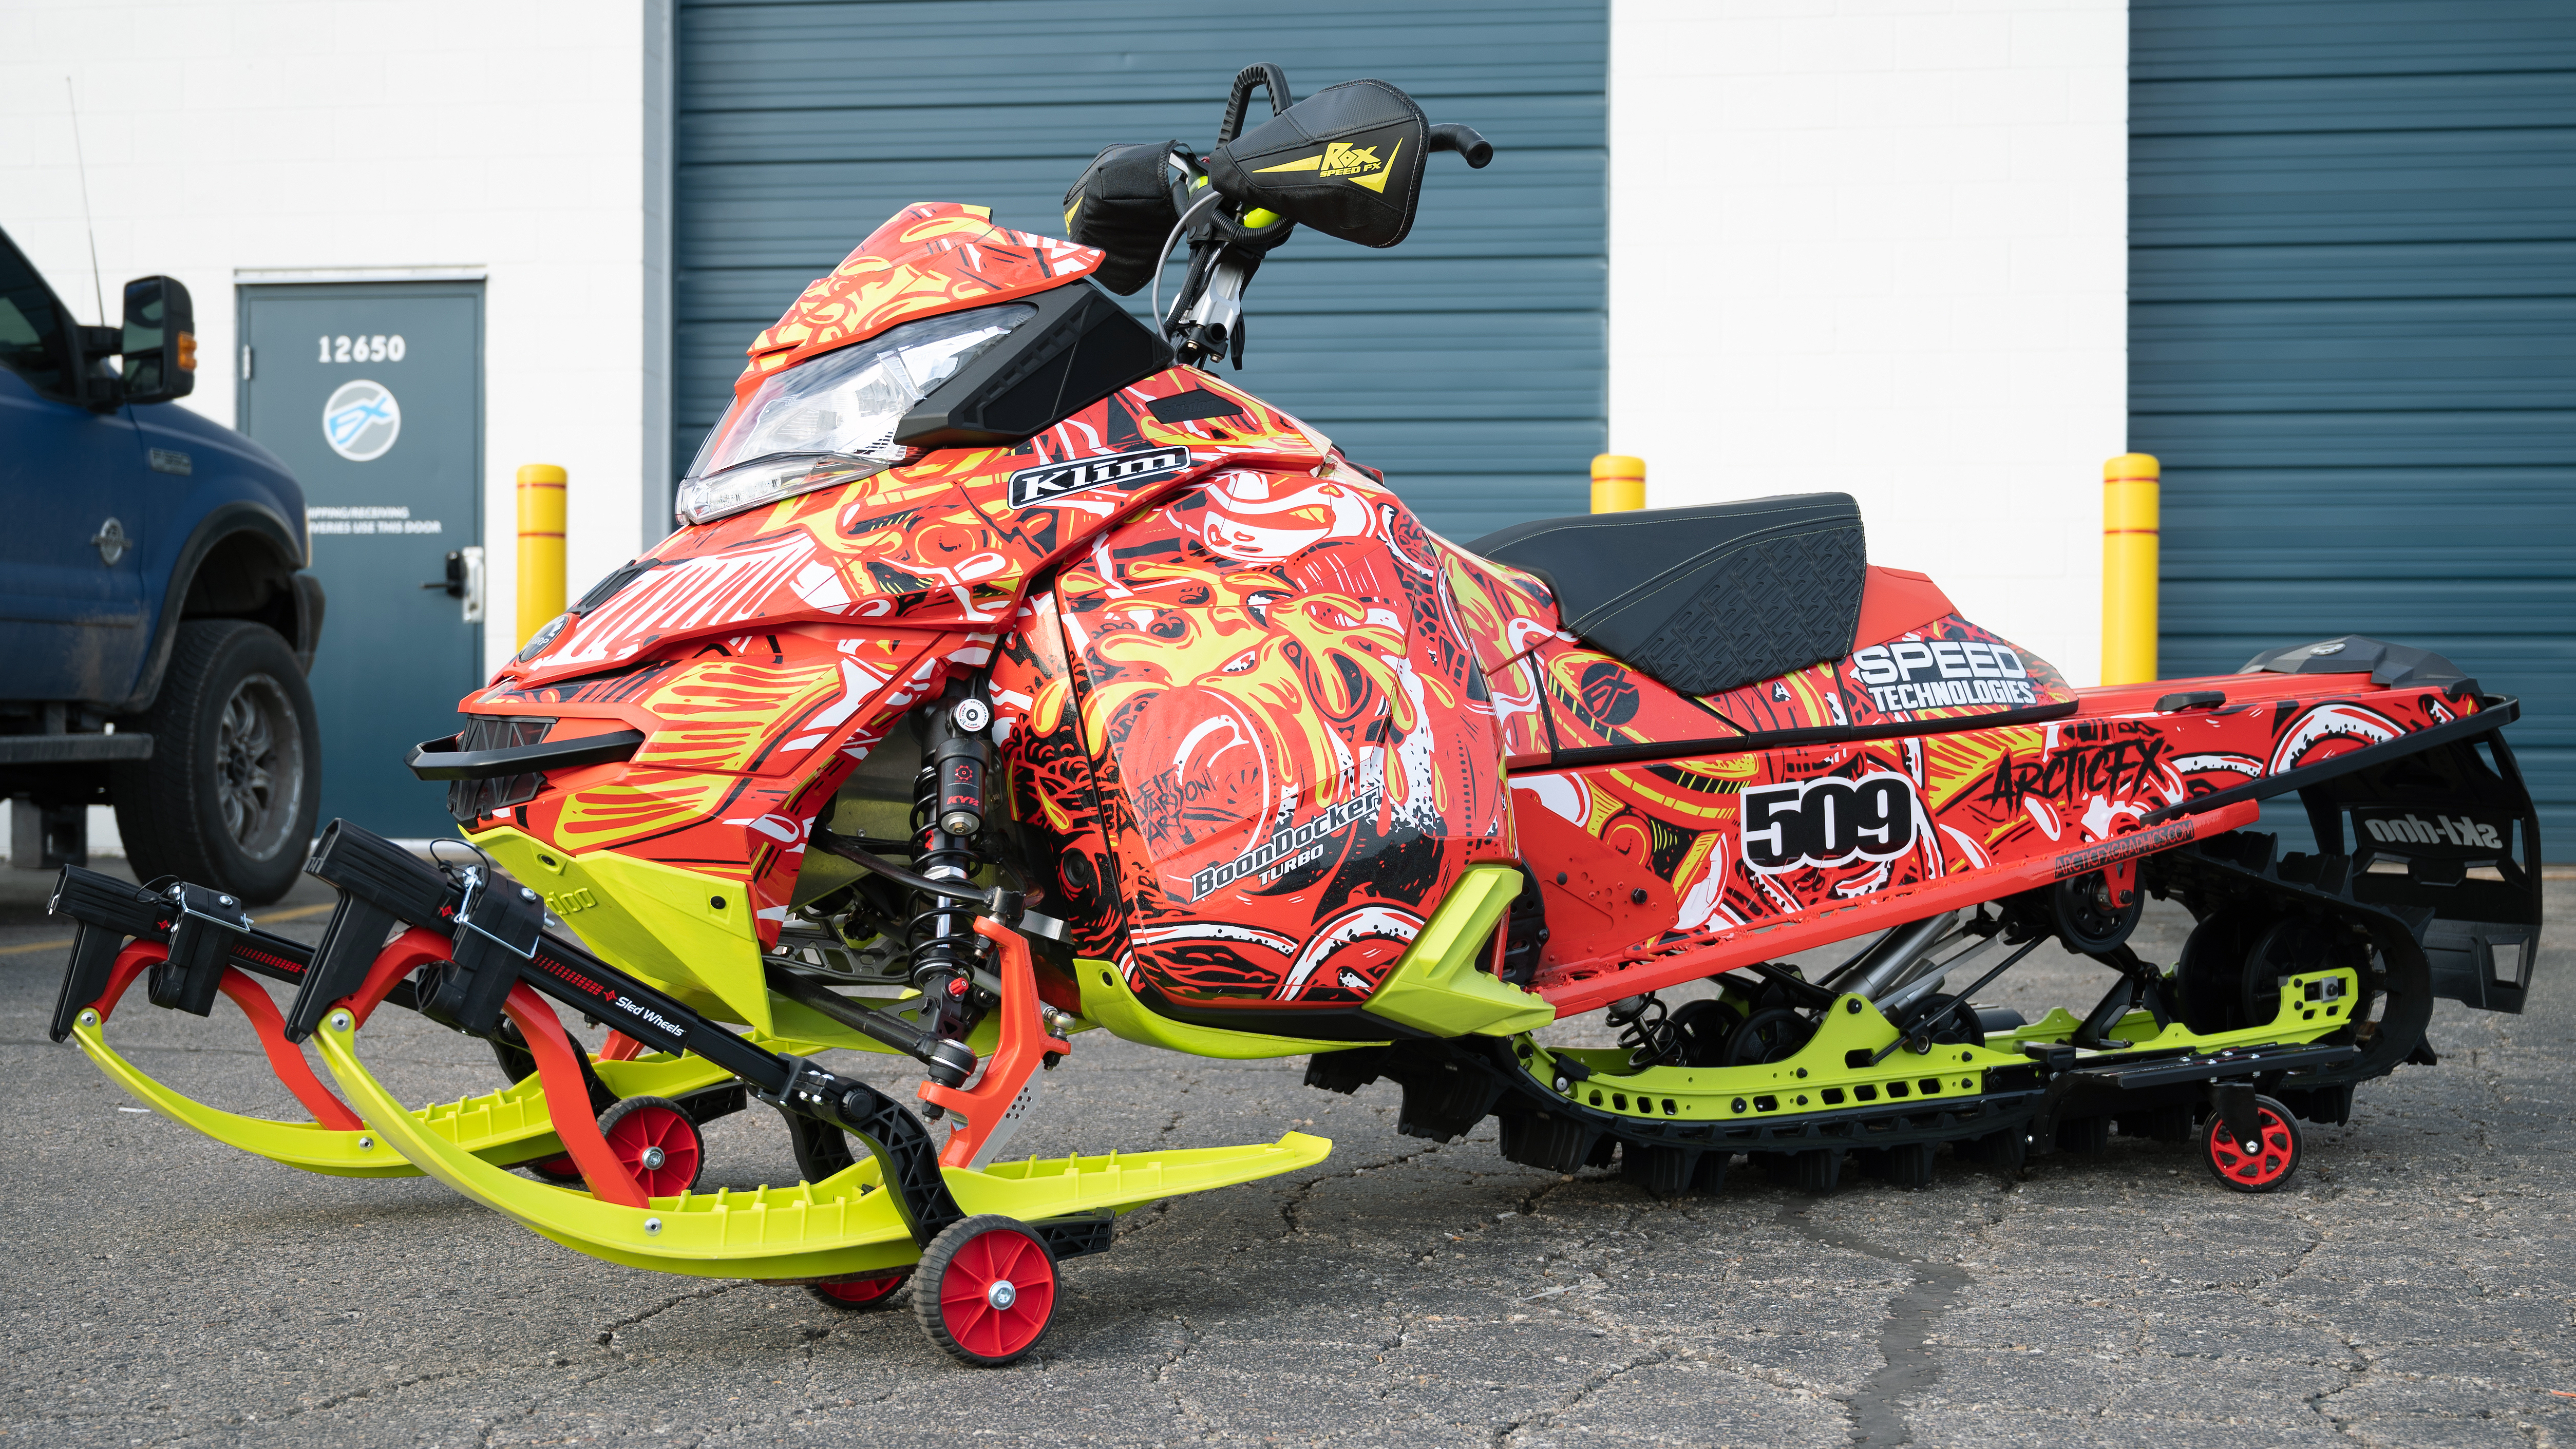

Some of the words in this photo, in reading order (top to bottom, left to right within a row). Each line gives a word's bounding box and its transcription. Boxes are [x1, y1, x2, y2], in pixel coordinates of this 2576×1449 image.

[1319, 166, 1361, 178] SPEED
[1363, 162, 1382, 172] FX
[319, 334, 406, 363] 12650
[353, 521, 375, 534] USE
[377, 521, 404, 534] THIS
[405, 520, 442, 534] DOOR
[532, 637, 550, 645] BRP
[1853, 641, 2026, 684] SPEED
[1868, 680, 2036, 712] TECHNOLOGIES
[1745, 776, 1912, 869] 509
[1258, 844, 1324, 887] TURBO
[2055, 822, 2194, 876] ARCTICFXGRAPHICS.COM
[615, 996, 645, 1016] Sled
[642, 1009, 684, 1037] Wheels
